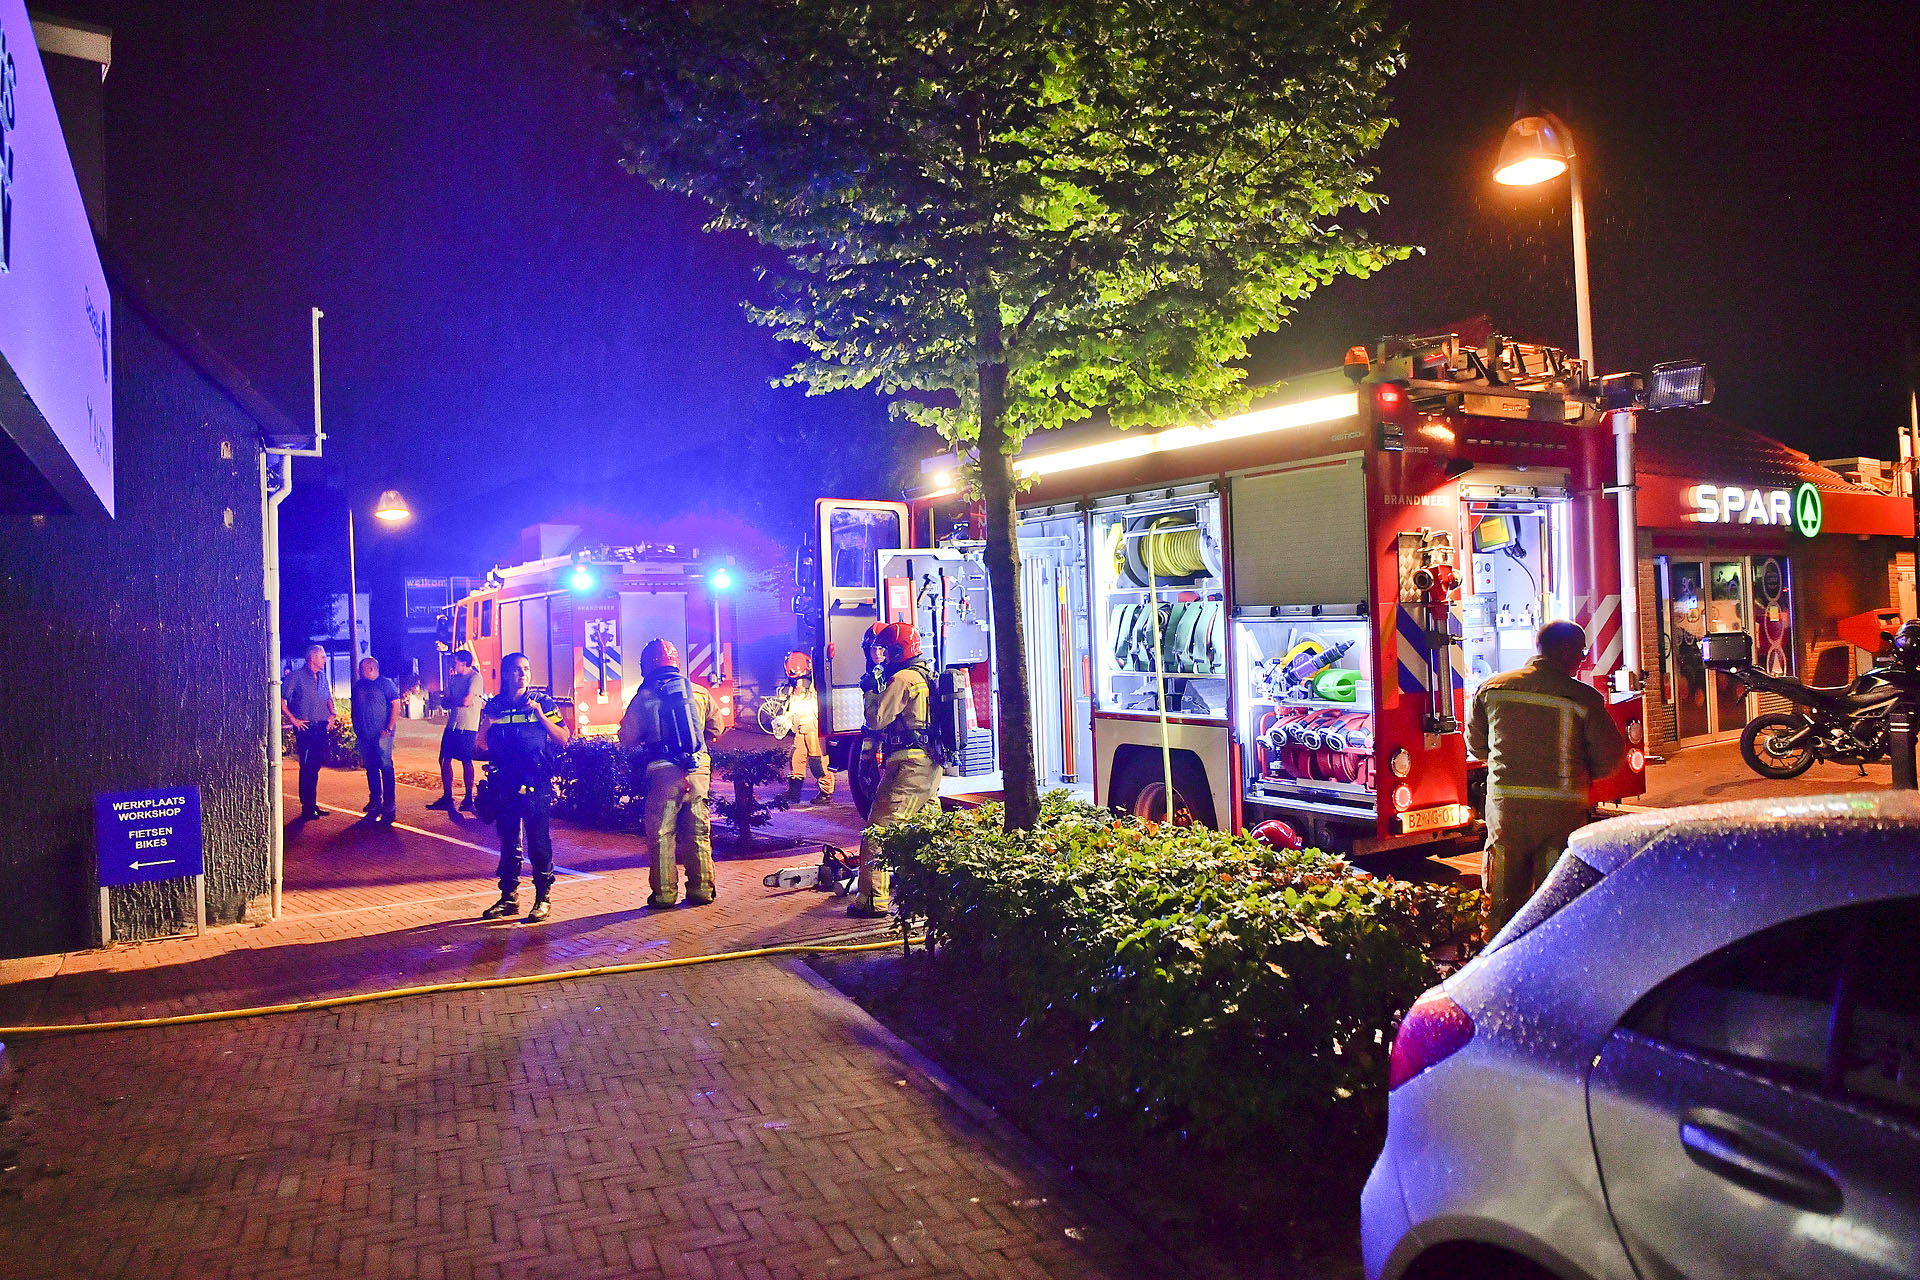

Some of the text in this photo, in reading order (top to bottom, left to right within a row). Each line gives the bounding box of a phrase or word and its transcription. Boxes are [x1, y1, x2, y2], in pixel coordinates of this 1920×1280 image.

[1694, 484, 1793, 526] SPAR
[112, 796, 186, 811] WERKPLAATS
[118, 807, 182, 821] WORKSHOP
[128, 826, 173, 839] FIETSEN
[135, 838, 168, 850] BIKES
